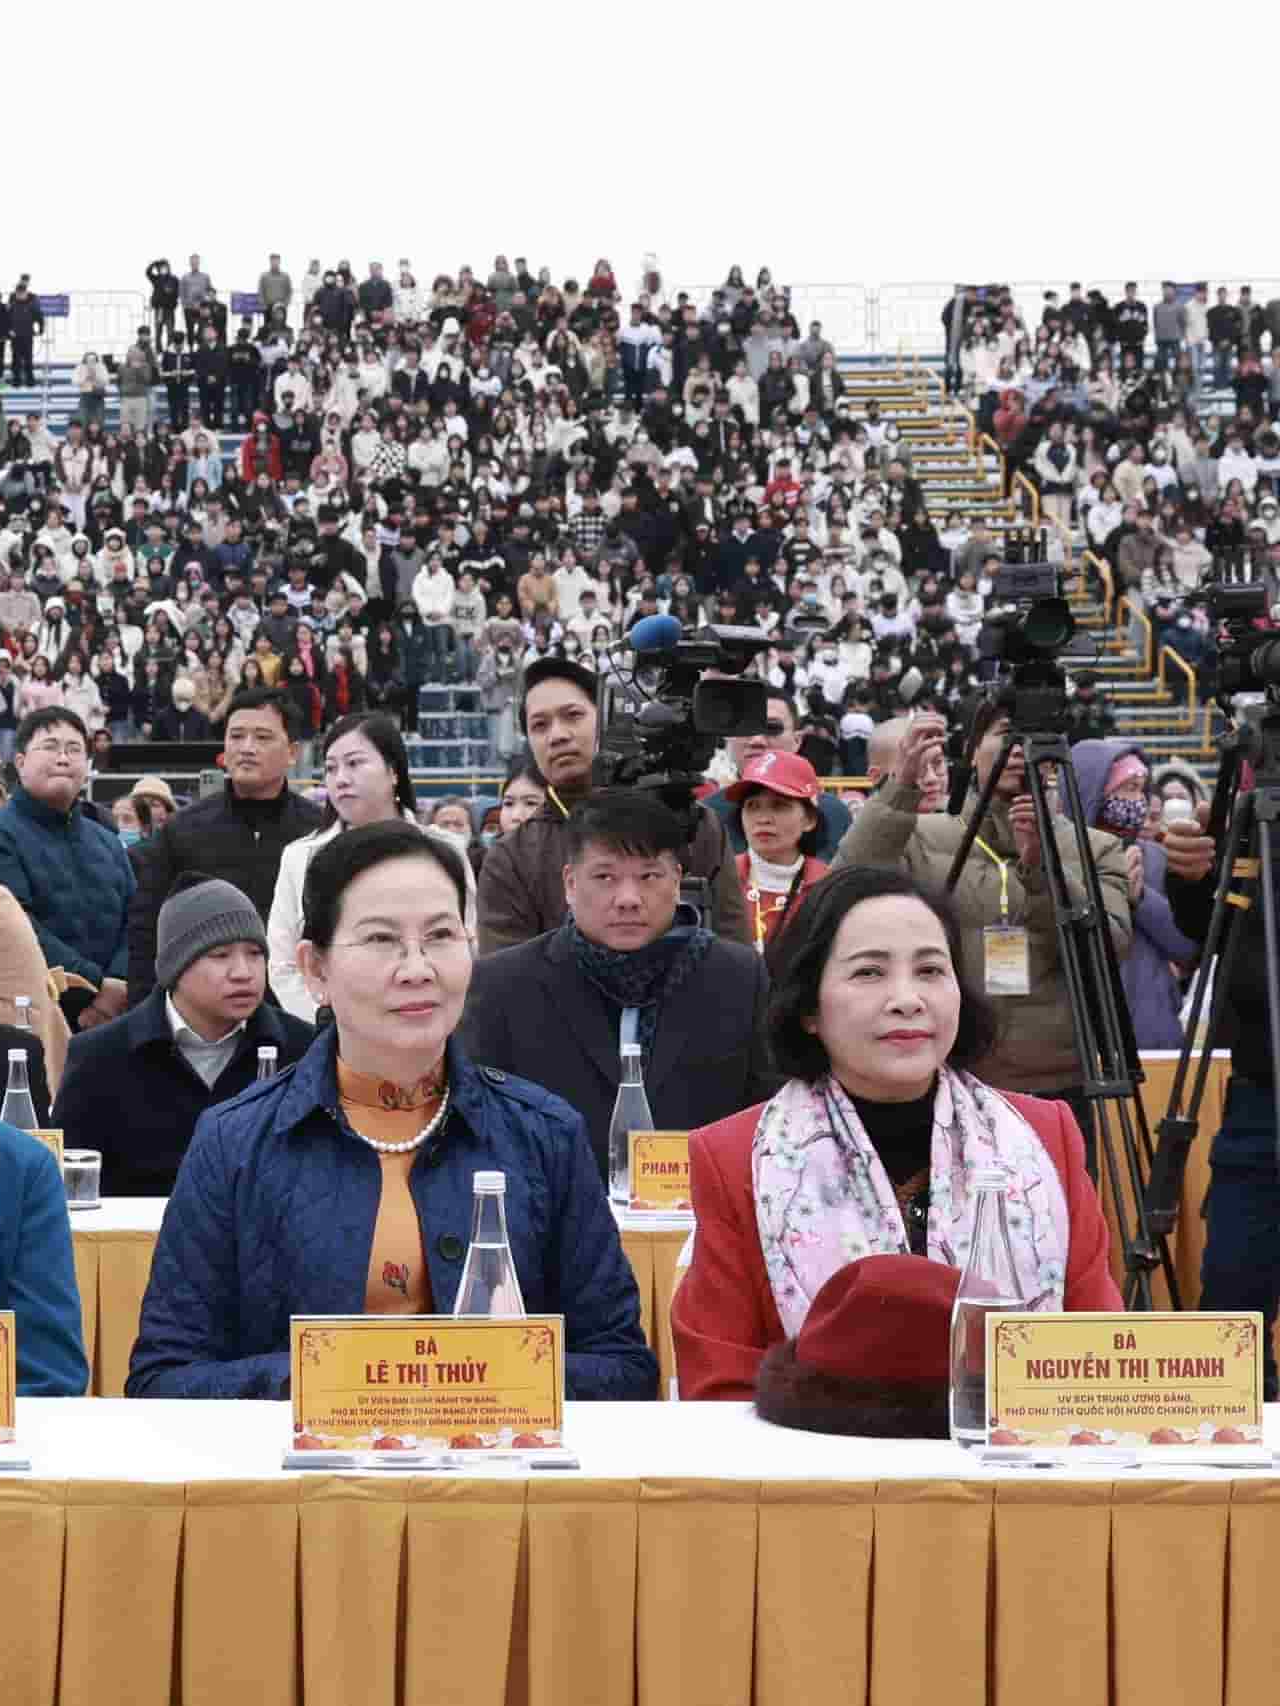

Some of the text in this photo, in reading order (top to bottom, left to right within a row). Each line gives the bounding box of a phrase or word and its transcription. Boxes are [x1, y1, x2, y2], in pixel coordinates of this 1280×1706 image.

[415, 1336, 438, 1355] BÀ
[1113, 1330, 1137, 1350] BÀ
[366, 1356, 488, 1388] LÊ THỊ THỦY
[1026, 1352, 1225, 1383] NGUYỄN THỊ THANH
